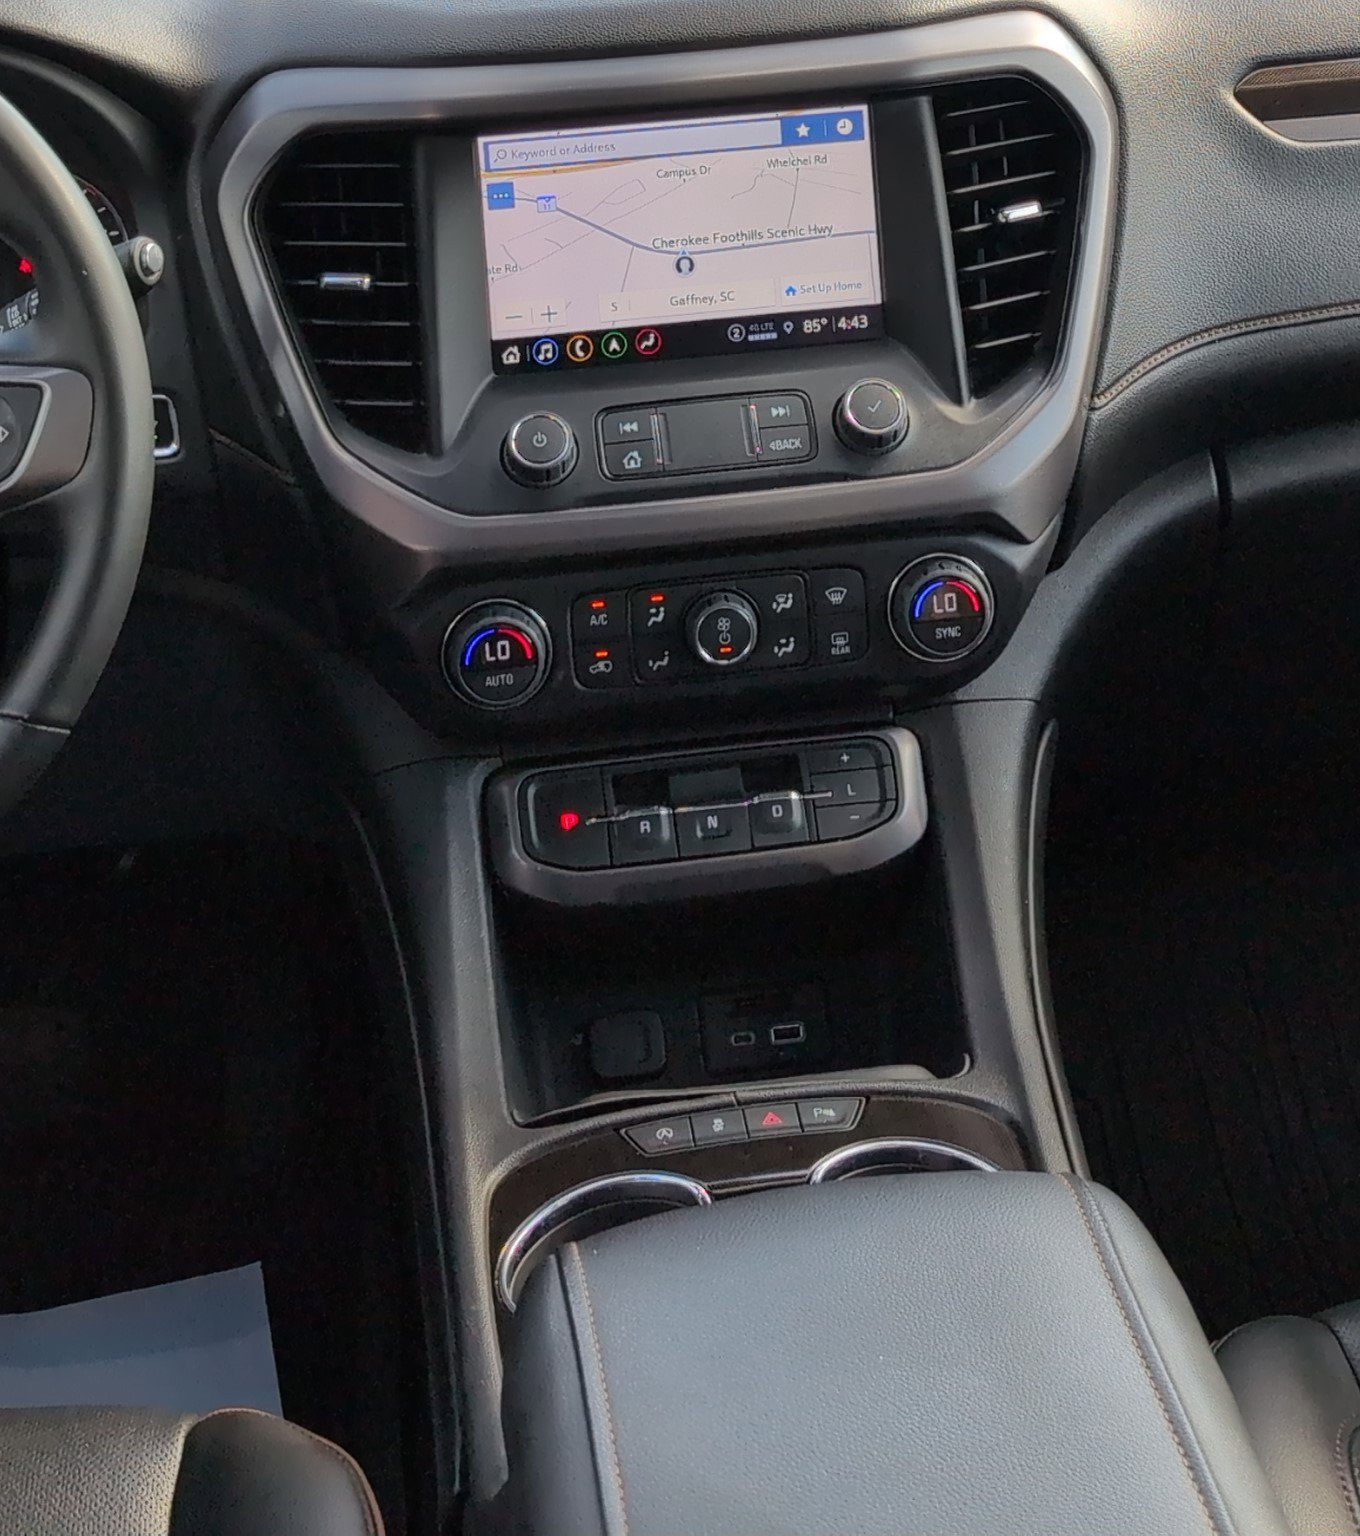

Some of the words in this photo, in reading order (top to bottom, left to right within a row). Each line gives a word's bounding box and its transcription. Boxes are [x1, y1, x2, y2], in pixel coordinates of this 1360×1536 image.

[511, 146, 557, 162] Keyword
[559, 146, 570, 156] or
[572, 142, 617, 154] Address
[814, 154, 828, 165] Rd
[656, 168, 697, 180] Campus
[699, 165, 712, 176] Dr
[652, 234, 710, 250] Cherokee
[712, 229, 764, 244] Foothills
[767, 225, 806, 239] Scenic
[808, 223, 834, 238] Hwy
[505, 263, 518, 273] Rd
[800, 284, 817, 295] Set
[819, 282, 832, 294] Up
[834, 281, 863, 292] Home
[669, 292, 717, 307] Gaffney,
[720, 290, 736, 302] SC
[838, 314, 869, 330] 4:43
[775, 437, 803, 451] BACK
[932, 592, 958, 614] LO
[589, 613, 609, 627] A/C
[934, 626, 962, 640] SYNC
[484, 640, 510, 662] LO
[830, 645, 851, 657] REAR
[485, 672, 515, 688] AUTO
[846, 783, 857, 797] L
[772, 803, 783, 818] D
[560, 811, 580, 831] P
[640, 820, 652, 834] R
[707, 814, 719, 830] N
